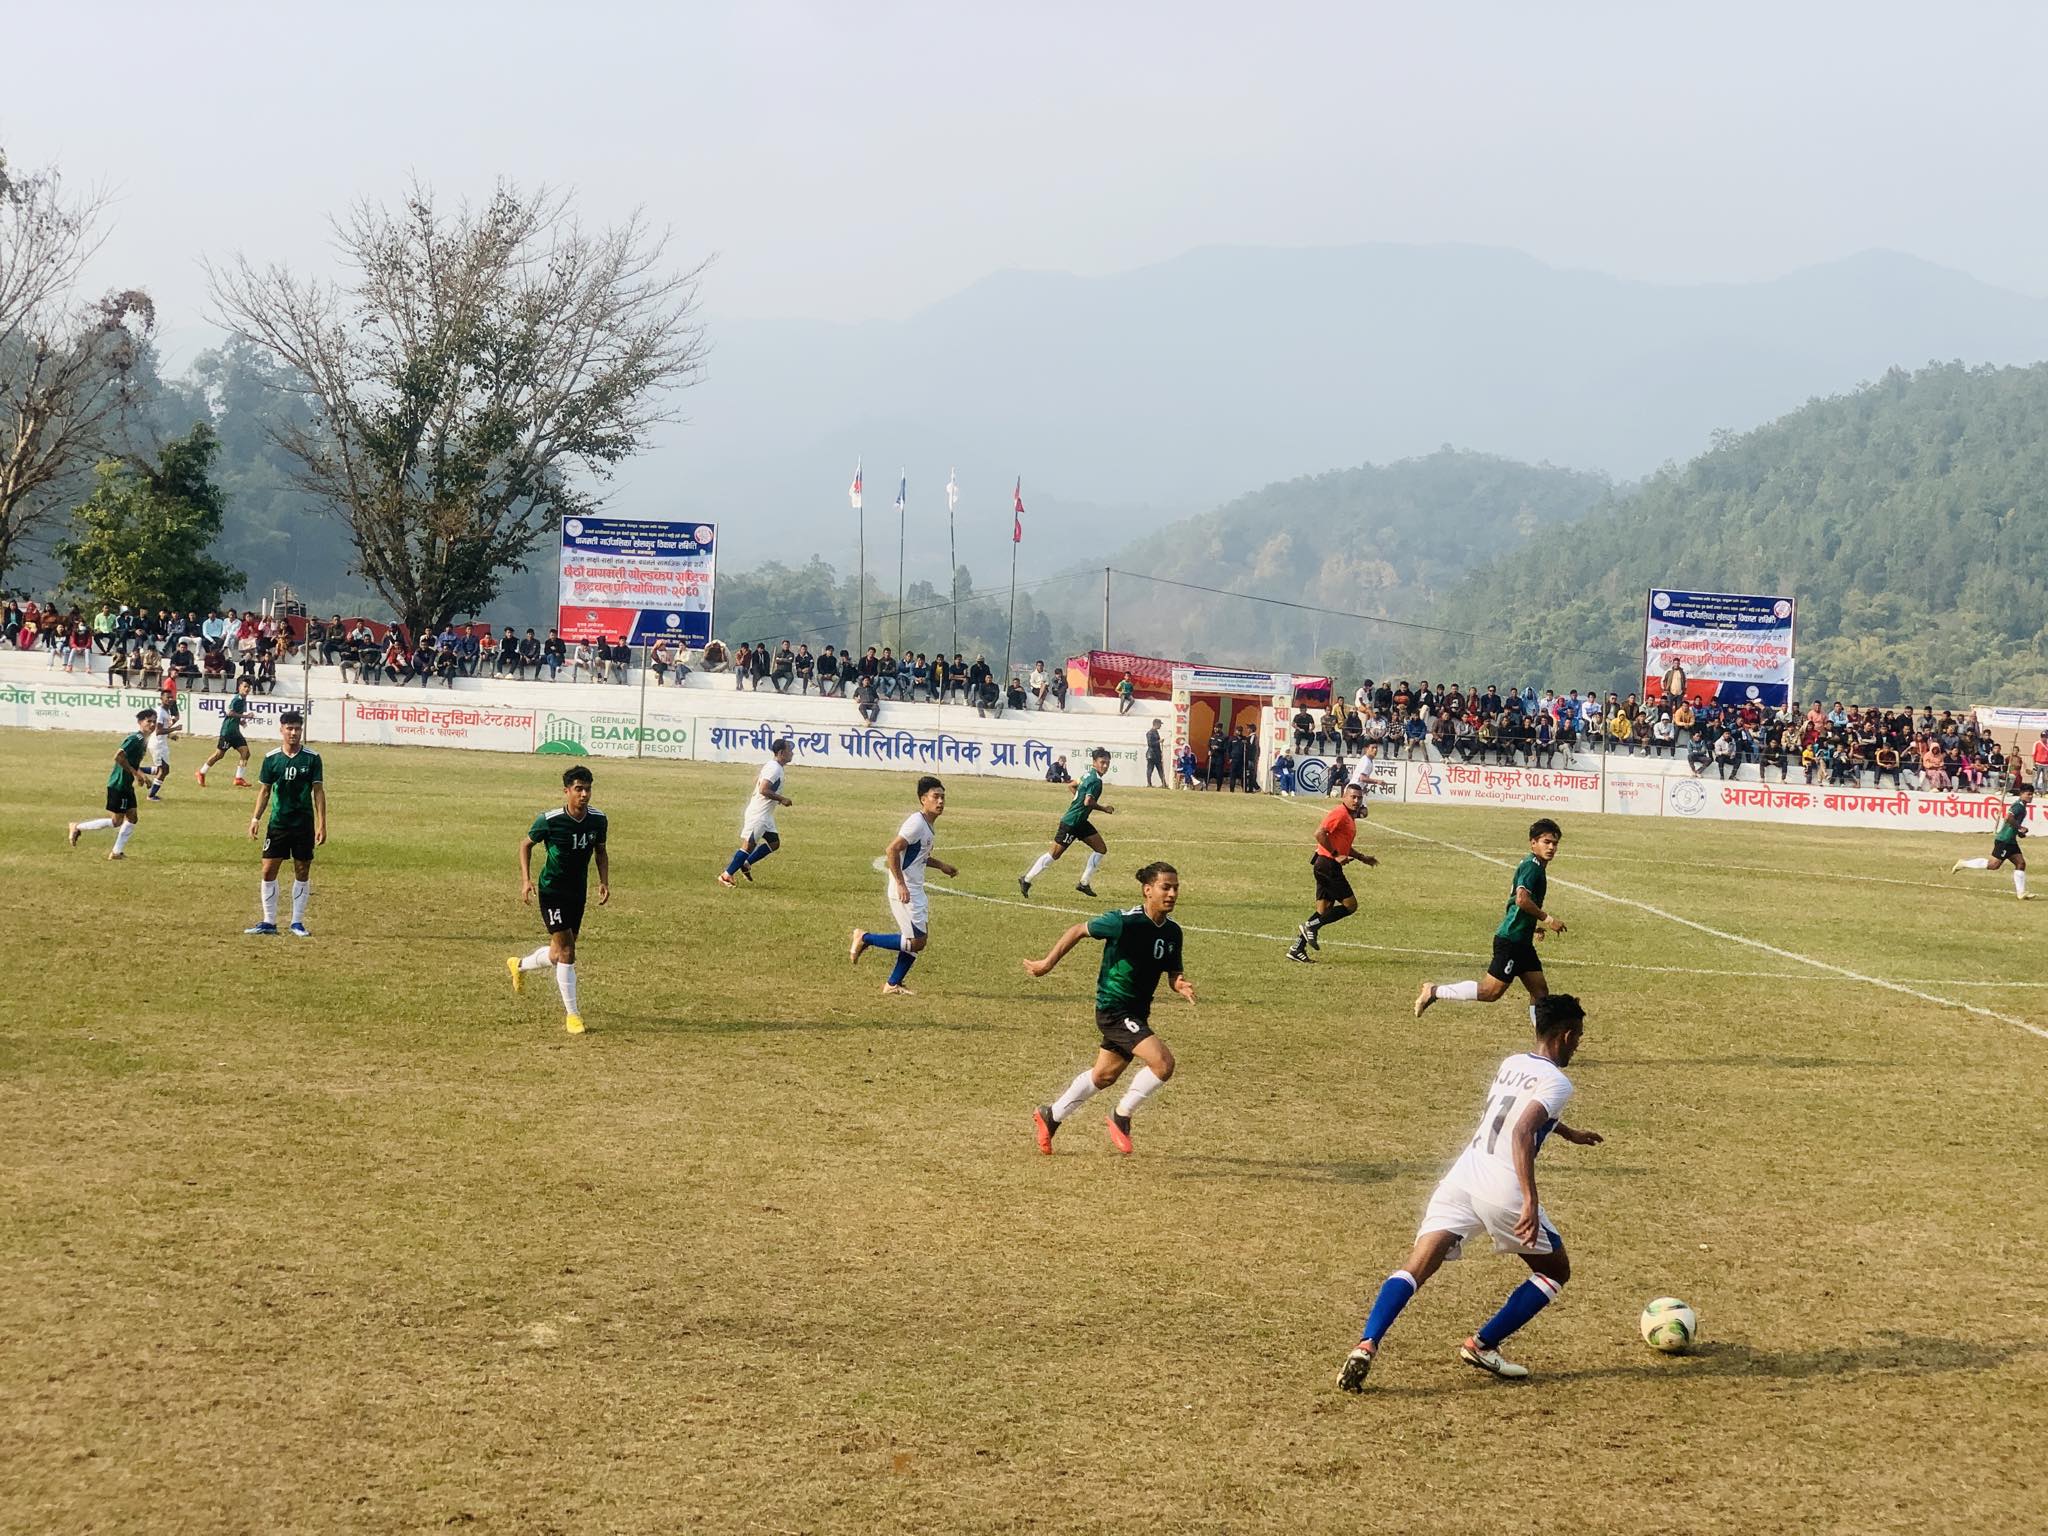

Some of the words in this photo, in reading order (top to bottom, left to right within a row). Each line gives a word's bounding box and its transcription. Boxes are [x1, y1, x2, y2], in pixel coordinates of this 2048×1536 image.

[401, 704, 429, 723] फोटो
[431, 708, 480, 728] स्टुडियो
[590, 716, 636, 725] GREENLAND
[591, 725, 687, 744] BAMBOO
[591, 741, 635, 751] COTTAGE
[645, 744, 684, 753] RESORT
[839, 727, 983, 764] पोलिक्लिनिक
[284, 766, 297, 780] 19
[1446, 765, 1481, 785] रेडियो
[1823, 791, 1911, 816] बागमती
[572, 833, 588, 849] 14
[548, 908, 563, 926] 14
[1153, 938, 1165, 960] 6
[1504, 959, 1514, 974] 8
[1124, 1017, 1140, 1034] 6
